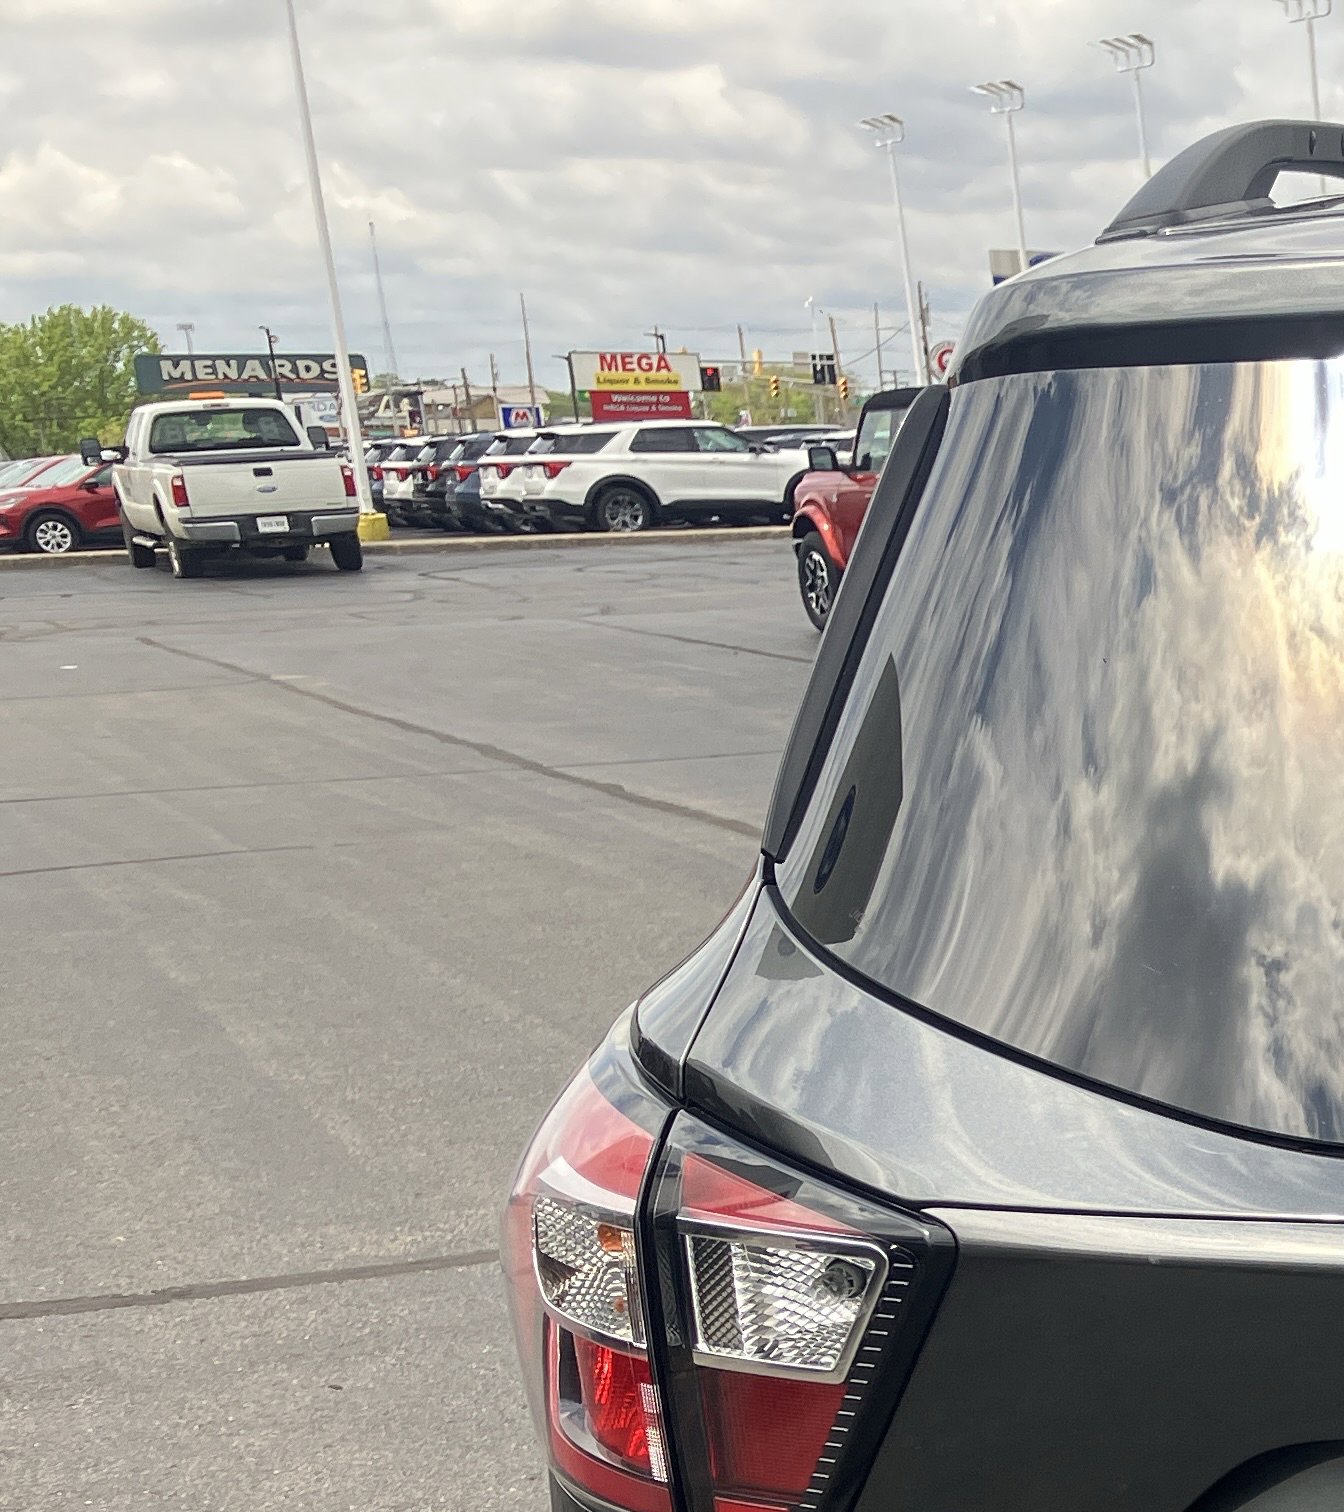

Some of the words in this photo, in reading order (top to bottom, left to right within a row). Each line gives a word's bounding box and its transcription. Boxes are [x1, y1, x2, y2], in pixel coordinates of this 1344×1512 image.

[160, 358, 339, 381] MENARDS
[599, 353, 672, 372] MEGA
[611, 394, 658, 402] Welcome
[659, 394, 670, 402] to
